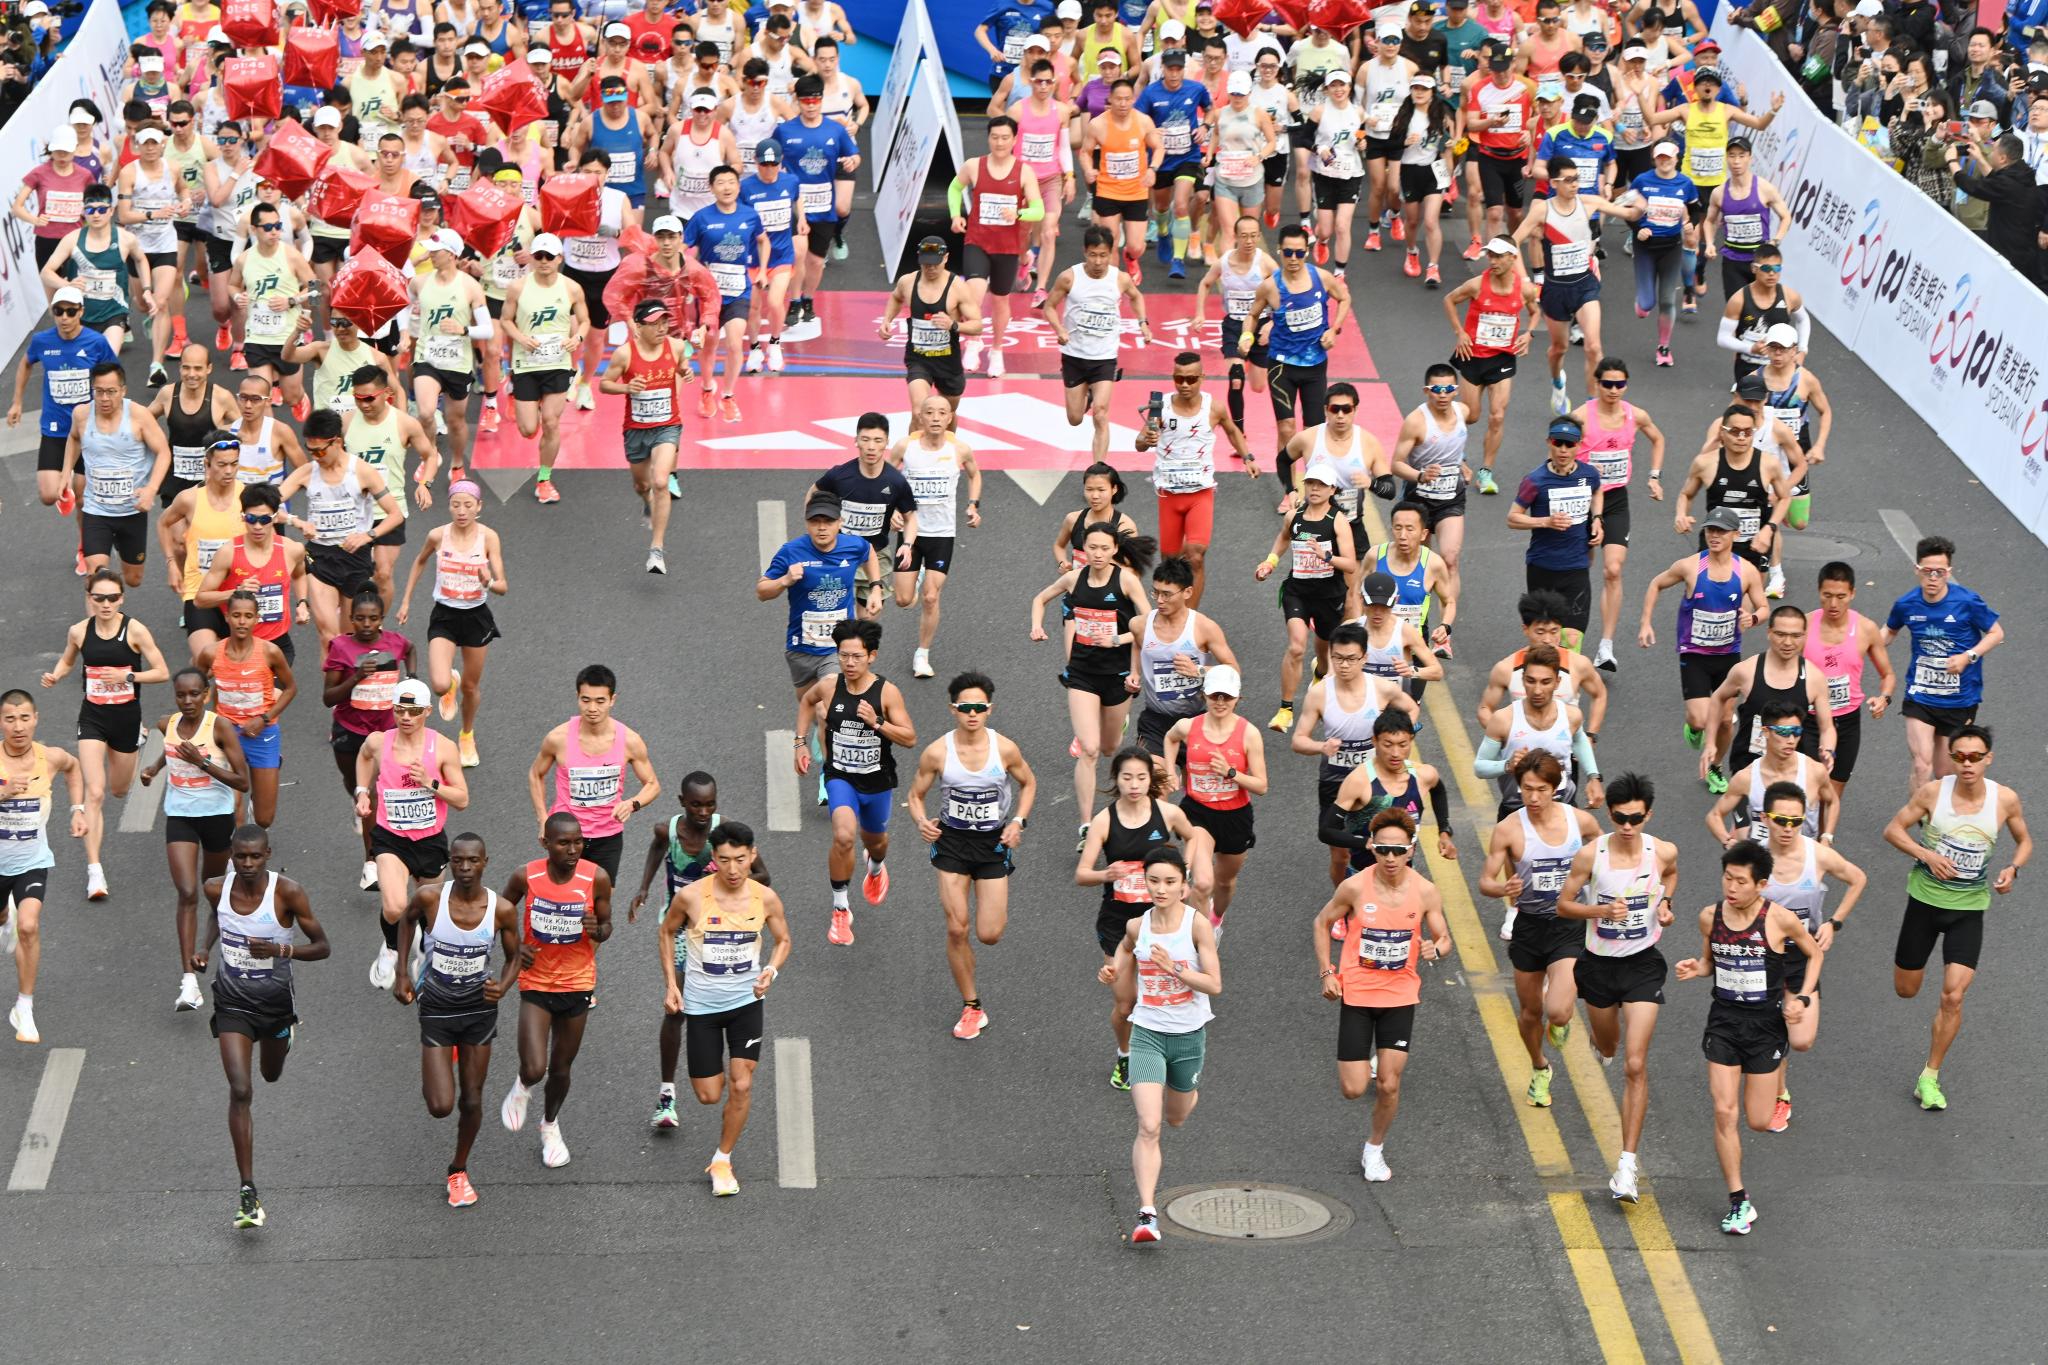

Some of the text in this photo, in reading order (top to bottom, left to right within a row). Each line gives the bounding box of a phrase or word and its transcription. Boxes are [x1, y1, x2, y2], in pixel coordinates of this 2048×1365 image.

[226, 3, 259, 15] 01:45
[232, 58, 266, 71] 01:45
[371, 202, 408, 217] 01:30
[1491, 327, 1507, 338] 124
[57, 381, 89, 395] A10051
[98, 481, 133, 495] A10749
[914, 481, 948, 495] A10327
[320, 513, 355, 528] A10460
[847, 515, 884, 529] A12188
[841, 719, 866, 730] ADIZERO
[840, 727, 862, 738] SUMMIT
[841, 748, 880, 763] A12168
[578, 778, 618, 797] A10447
[394, 803, 436, 820] A10002
[957, 803, 990, 820] PACE
[535, 915, 553, 924] Felix
[543, 925, 570, 934] KIRWA
